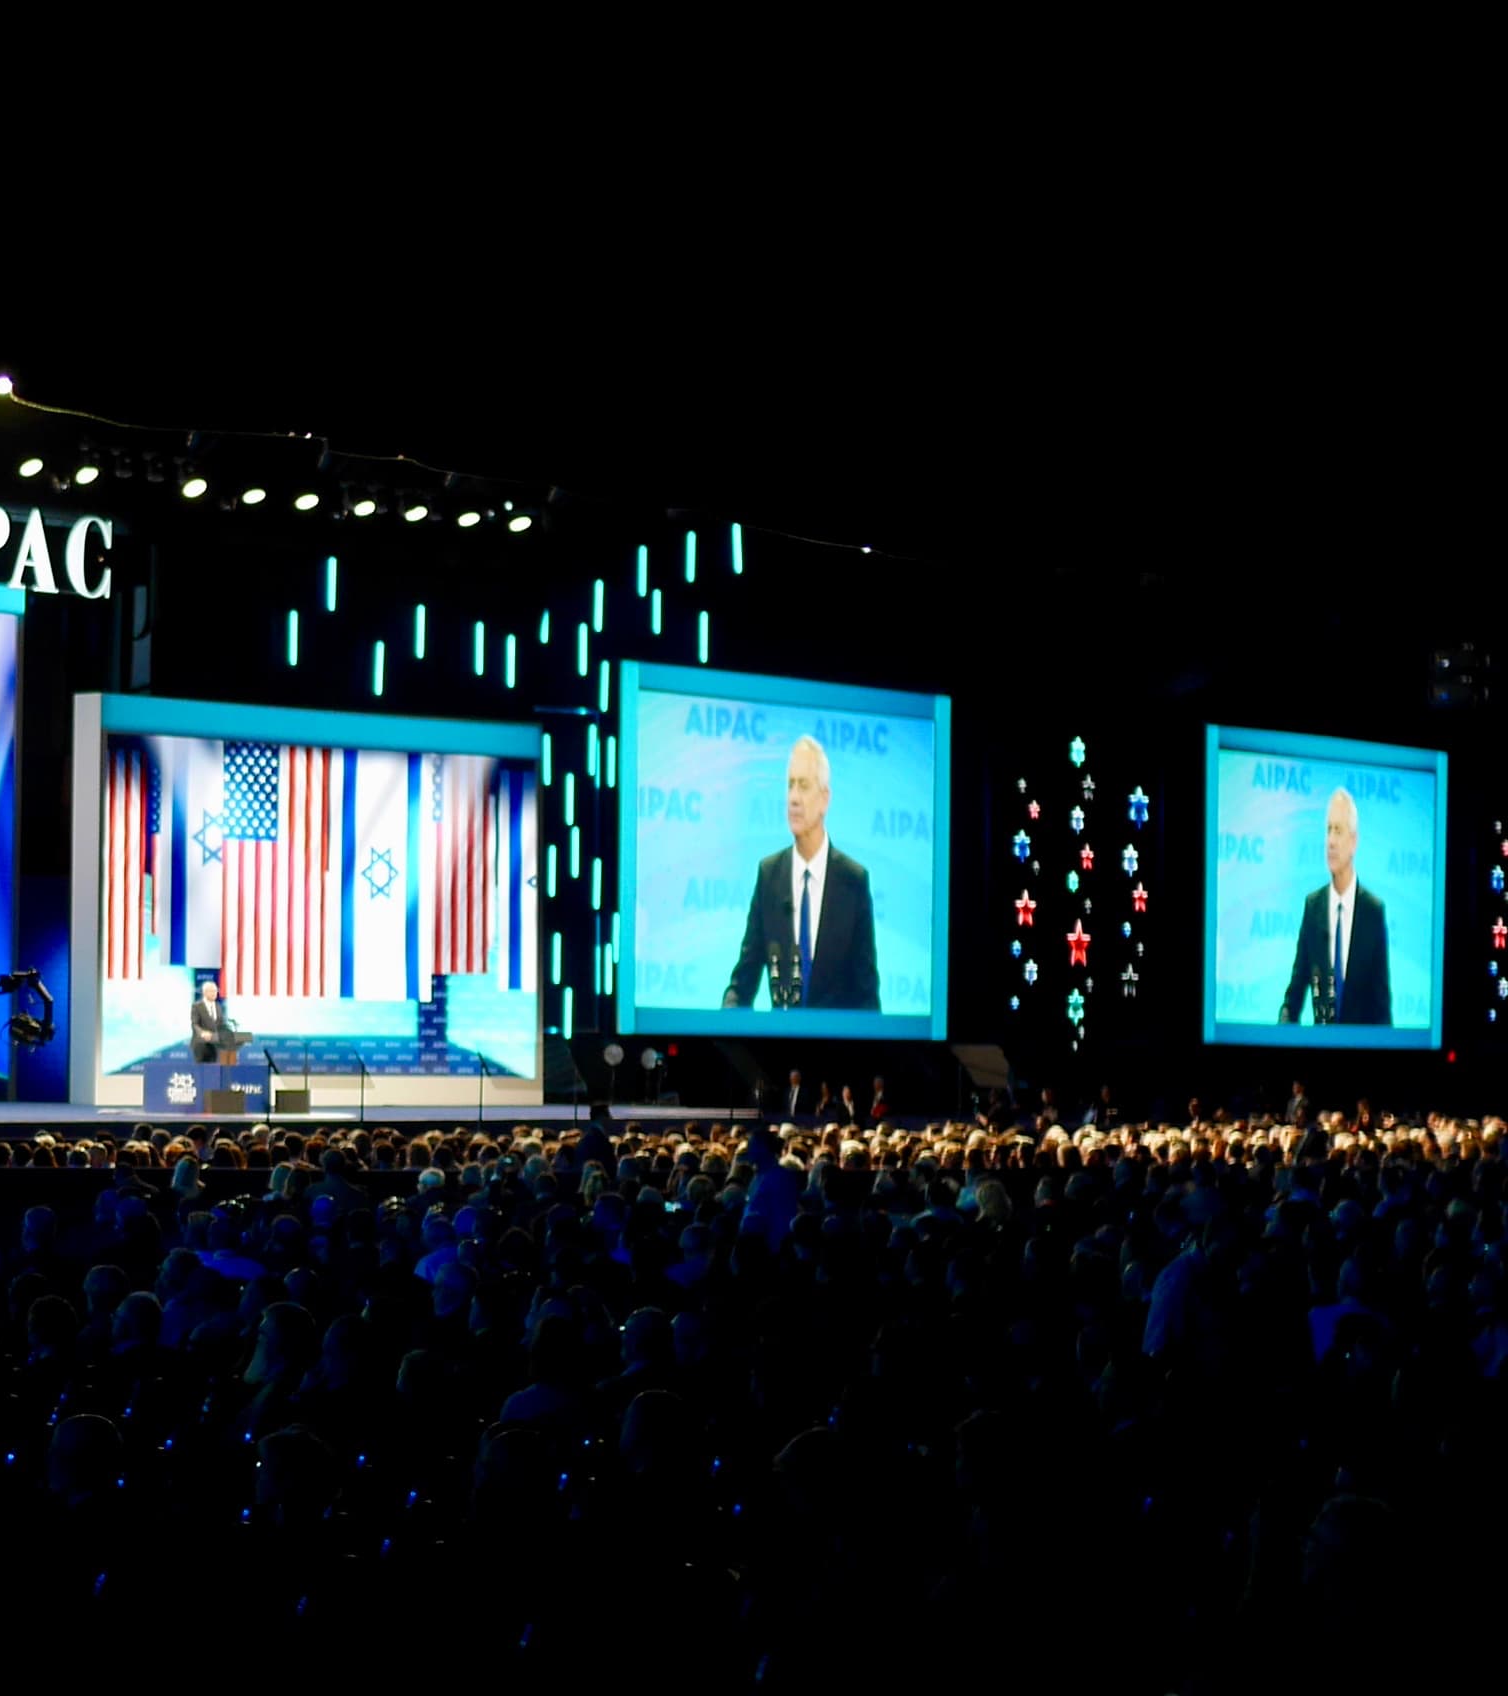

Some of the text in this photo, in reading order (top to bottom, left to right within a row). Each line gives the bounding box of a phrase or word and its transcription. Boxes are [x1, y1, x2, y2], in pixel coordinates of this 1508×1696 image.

[685, 703, 768, 743] AIPAC
[814, 716, 889, 755] AIPAC
[1253, 762, 1312, 795] AIPAC
